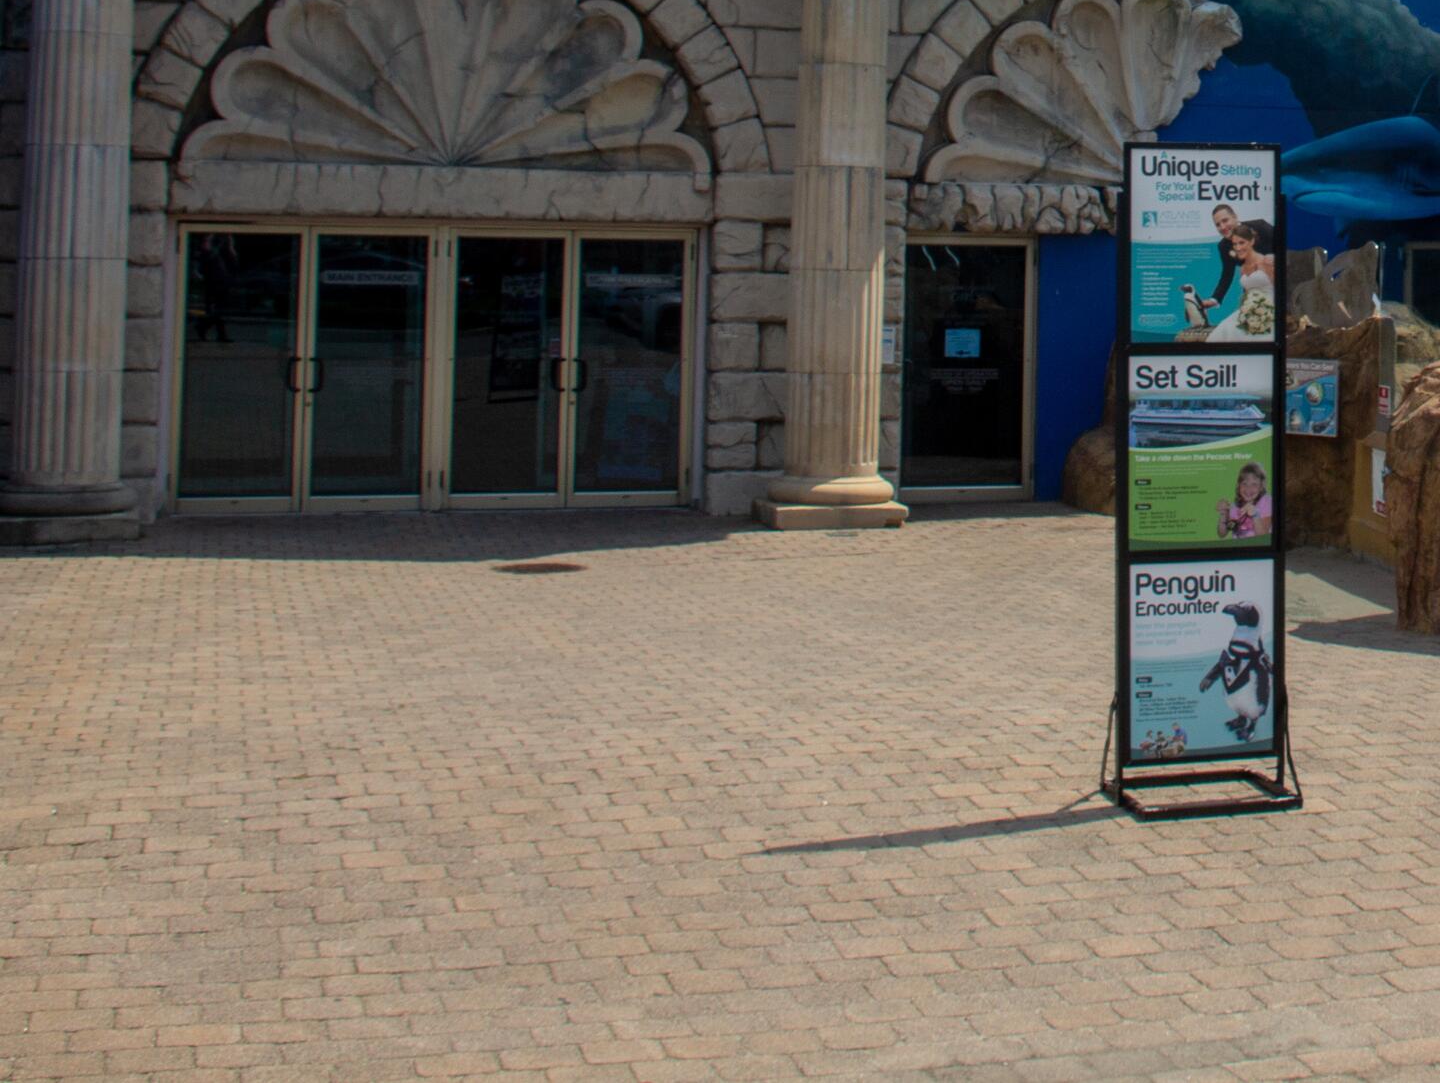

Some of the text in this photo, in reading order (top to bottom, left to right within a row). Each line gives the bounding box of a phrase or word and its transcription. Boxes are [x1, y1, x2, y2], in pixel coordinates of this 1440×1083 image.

[1141, 155, 1219, 181] Unique
[1156, 180, 1260, 201] For Your Event
[1158, 192, 1195, 202] Special
[1135, 364, 1237, 389] Set Sail!
[1135, 570, 1235, 600] Penguin
[1135, 600, 1219, 617] Encounter
